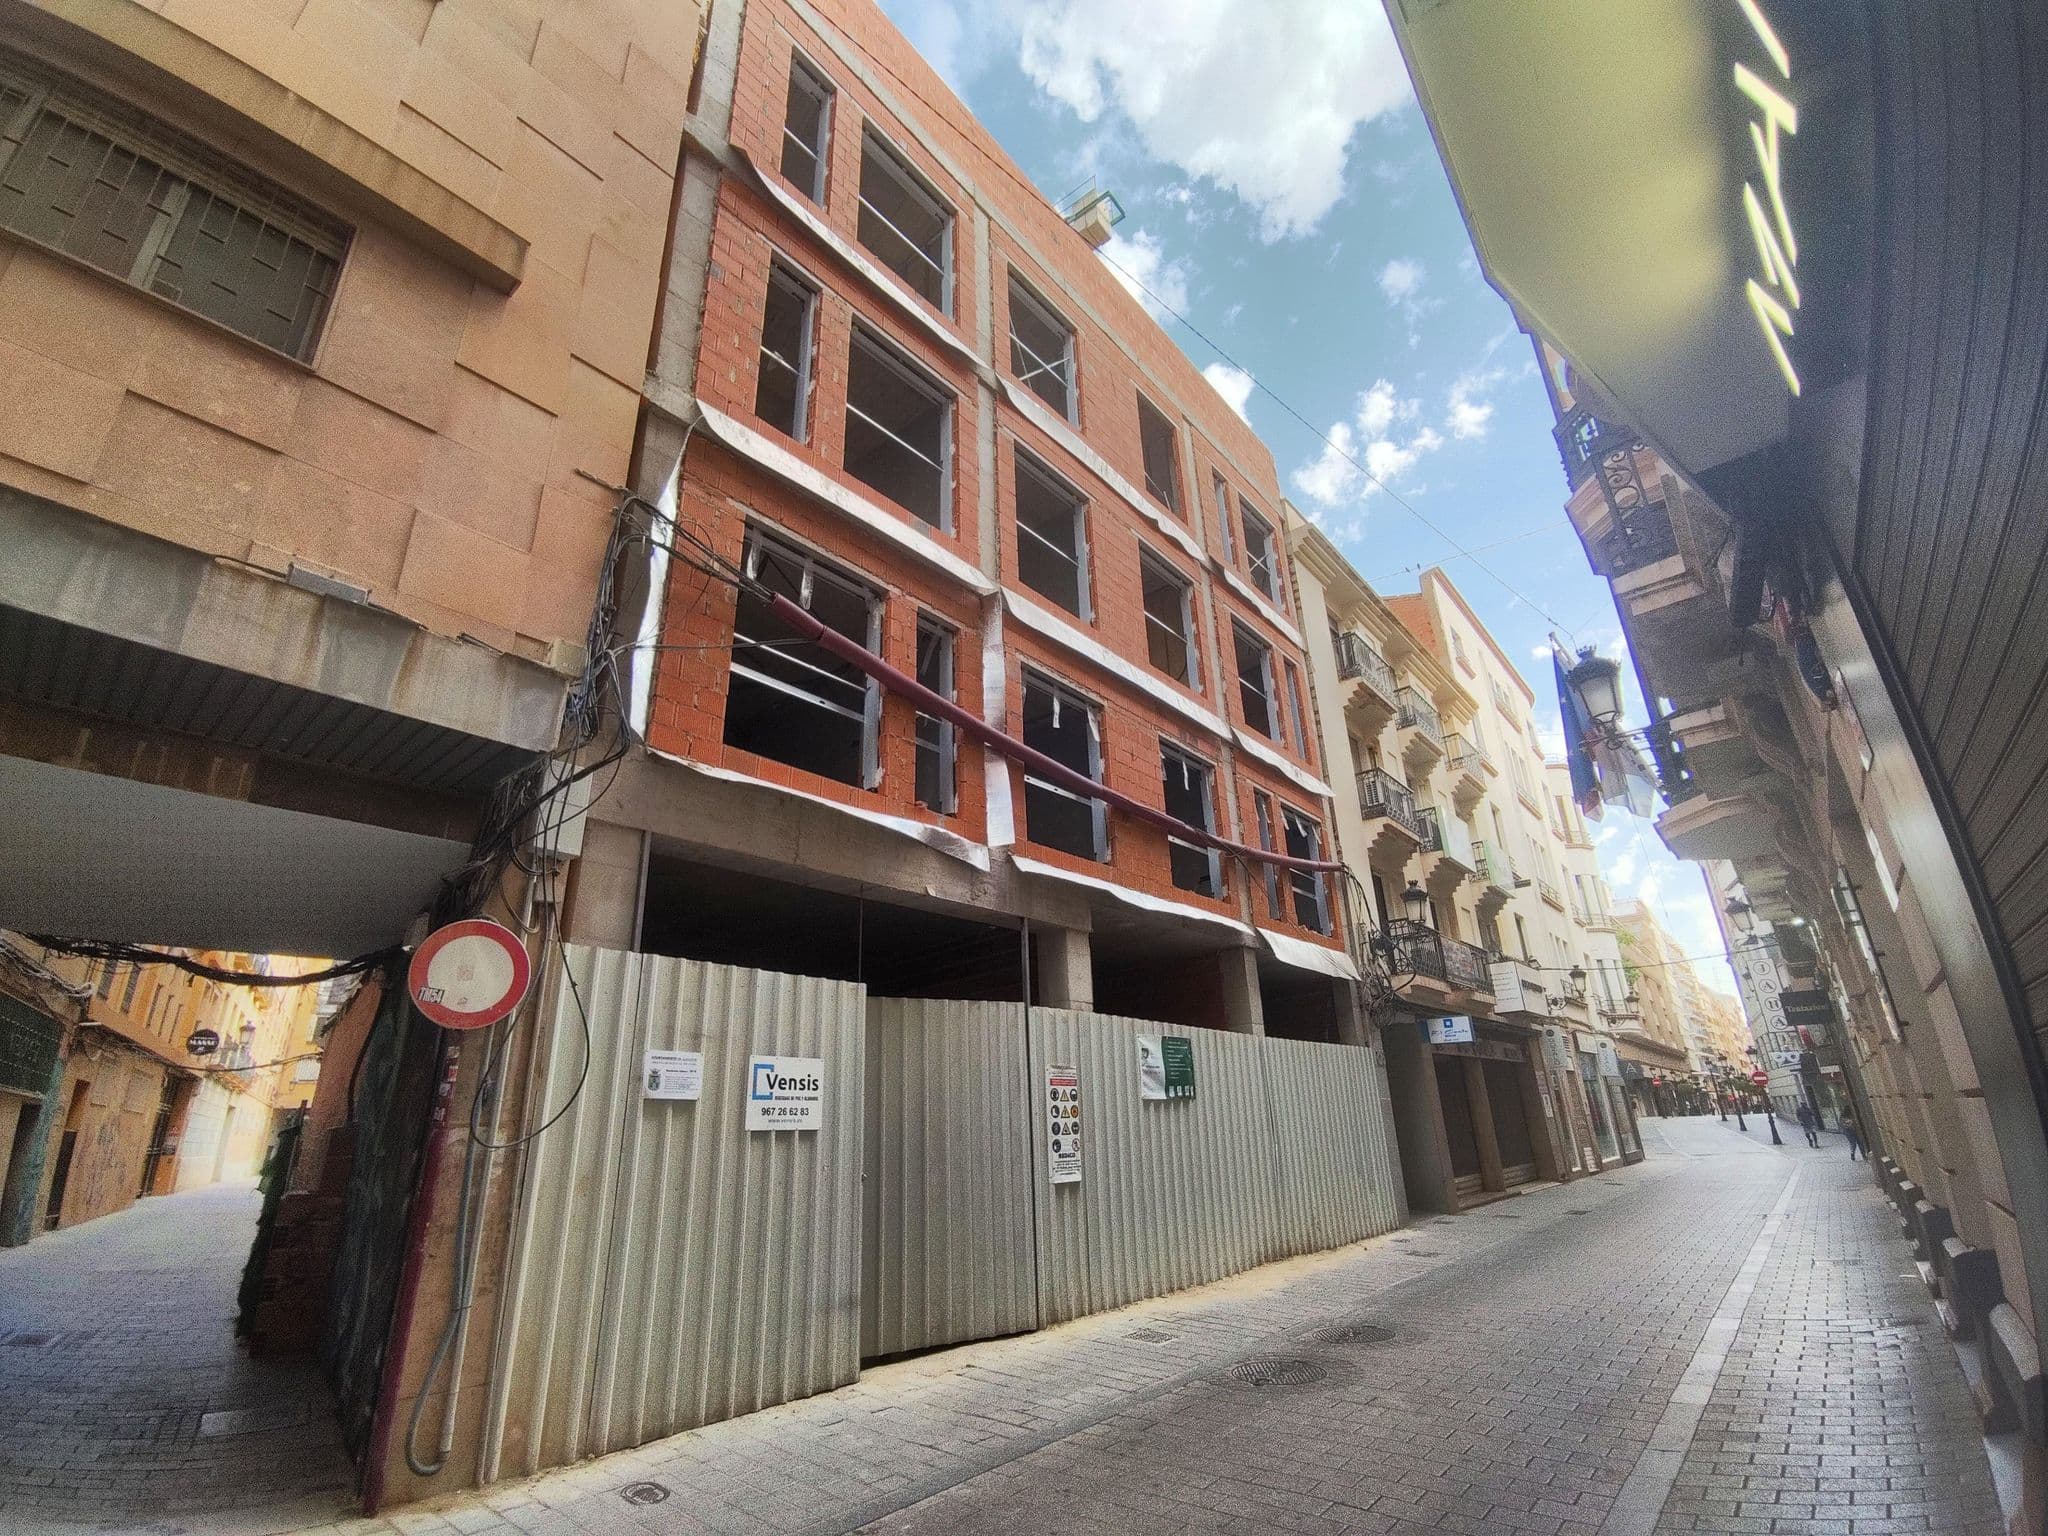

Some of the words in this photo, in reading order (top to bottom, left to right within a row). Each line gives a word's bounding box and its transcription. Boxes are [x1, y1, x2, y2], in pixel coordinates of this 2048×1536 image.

[766, 1073, 819, 1091] Vensis
[761, 1107, 776, 1116] 967
[777, 1107, 787, 1116] 26
[789, 1107, 798, 1116] 62
[800, 1108, 809, 1116] 83
